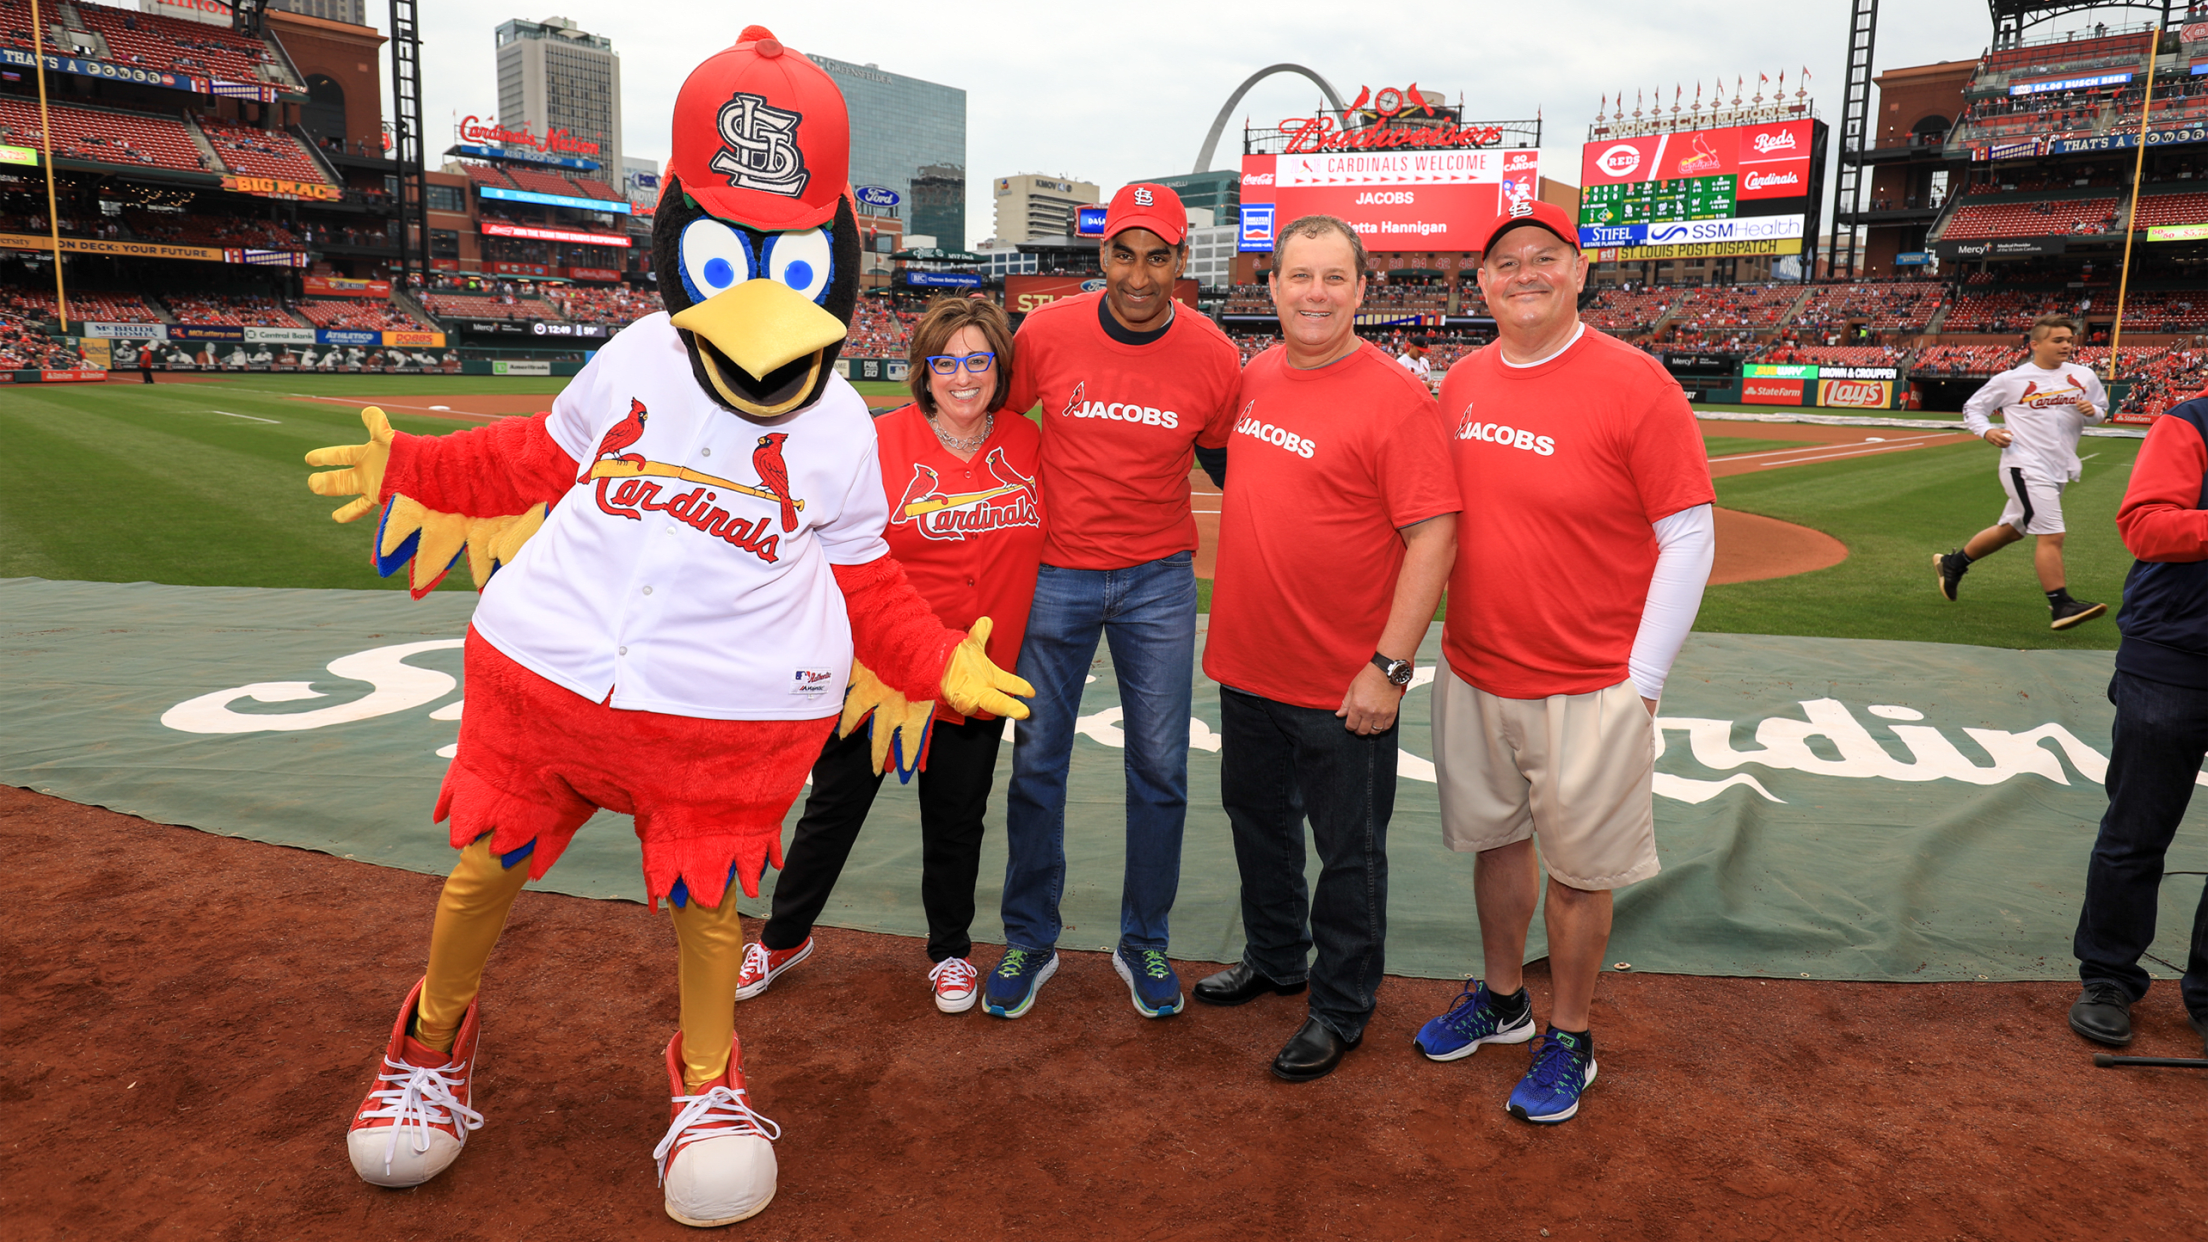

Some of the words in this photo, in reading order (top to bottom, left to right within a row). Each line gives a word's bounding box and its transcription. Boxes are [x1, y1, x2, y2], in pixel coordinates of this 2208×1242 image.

[67, 59, 79, 72] A
[88, 62, 160, 84] POWER
[826, 60, 893, 85] GREENSFELDER
[2034, 82, 2062, 92] $5.00
[2065, 78, 2098, 88] BUSCH
[2101, 74, 2126, 84] BEER
[1608, 118, 1671, 136] WORLD
[1675, 104, 1790, 128] CHAMPIONS
[460, 115, 537, 146] Cardinals
[537, 127, 599, 155] Nation
[1278, 116, 1503, 154] Budweiser
[1753, 128, 1797, 154] Reds
[2063, 137, 2109, 151] THAT'S
[2115, 136, 2125, 147] A
[2134, 129, 2204, 145] POWER
[1328, 156, 1408, 173] CARDINALS
[1415, 154, 1488, 171] WELCOME
[1503, 160, 1538, 172] CARDS!
[1512, 154, 1528, 163] GO
[1608, 154, 1640, 167] REDS
[638, 173, 658, 188] FOX
[1035, 178, 1057, 190] KMOV
[1744, 170, 1799, 190] Cardinals
[235, 177, 274, 192] BIG
[276, 180, 328, 200] MAC
[864, 187, 893, 204] Ford
[268, 192, 298, 201] LAND
[556, 197, 576, 206] YOUR
[1355, 191, 1415, 205] JACOBS
[1381, 220, 1447, 236] Hannigan
[1592, 226, 1633, 241] STIFEL
[80, 241, 119, 252] DECK:
[122, 244, 157, 254] YOUR
[161, 246, 212, 258] FUTURE.
[1621, 248, 1637, 259] ST.
[1640, 245, 1674, 258] LOUIS
[1678, 240, 1777, 257] POST-DISPATCH
[1958, 245, 1985, 255] Mercy
[1368, 258, 1381, 269] 17
[1389, 258, 1404, 269] 20
[1412, 258, 1427, 269] 24
[1435, 258, 1451, 269] 42
[1459, 258, 1474, 269] 45
[473, 323, 494, 332] Mercy
[547, 325, 572, 335] 12:49
[260, 331, 290, 339] Central
[292, 332, 313, 340] Bank
[325, 331, 374, 340] ATHLETICO
[396, 333, 433, 341] DOBBS
[864, 360, 879, 368] FOX
[1672, 358, 1692, 366] Mercy
[864, 370, 878, 378] GO
[1754, 365, 1807, 376] SUBWAY
[1819, 367, 1847, 378] BROWN
[1847, 368, 1854, 378] &
[1854, 368, 1897, 379] CROUPPEN
[1073, 400, 1179, 429] JACOBS
[1238, 417, 1316, 459] JACOBS
[1459, 422, 1555, 456] JACOBS
[595, 453, 780, 564] Cardinals
[917, 494, 1040, 541] Cardinals
[1560, 1035, 1574, 1046] NIKE
